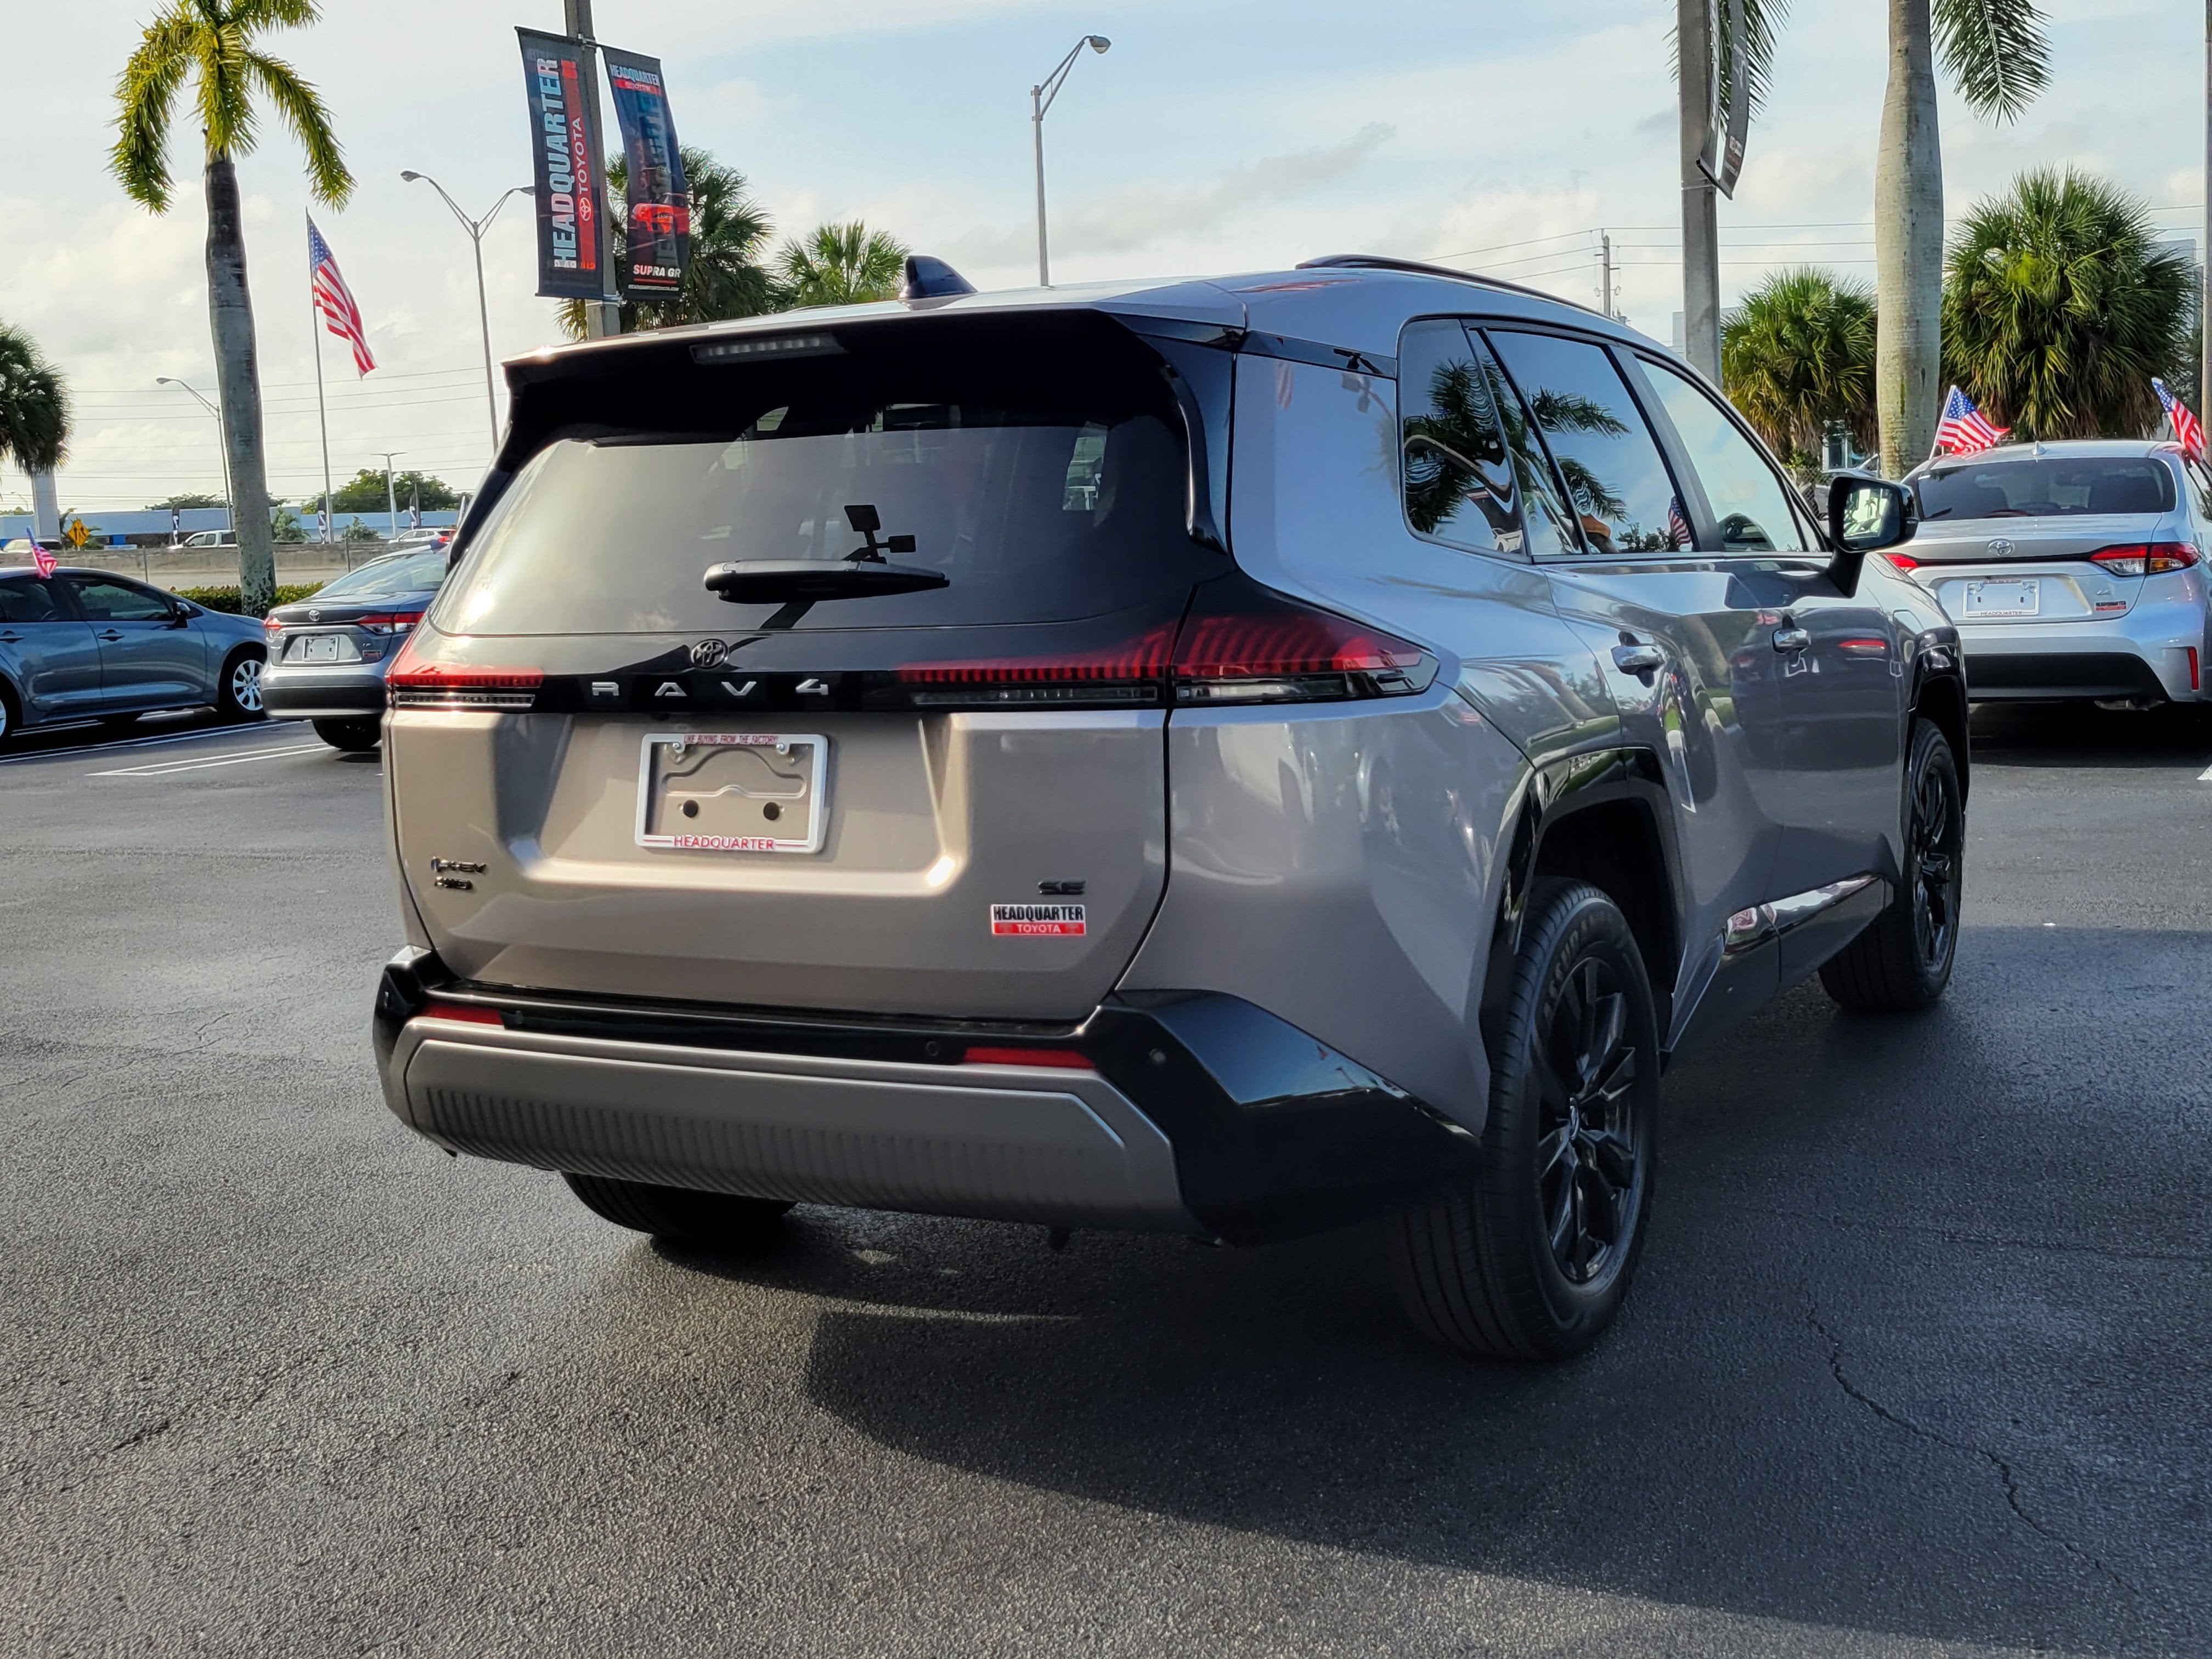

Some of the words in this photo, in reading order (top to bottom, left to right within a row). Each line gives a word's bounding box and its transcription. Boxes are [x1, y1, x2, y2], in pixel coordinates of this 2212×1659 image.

[609, 64, 661, 87] HEADQUARTER
[537, 58, 577, 269] HEADQUARTER
[572, 117, 588, 195] TOYOTA
[633, 264, 665, 276] SUPRA
[667, 267, 681, 278] GR
[592, 679, 829, 697] RAV4
[674, 834, 774, 850] HEADQUARTER
[1039, 880, 1086, 895] SE
[993, 906, 1084, 922] HEADQUARTER
[1017, 924, 1061, 933] TOYOTA
